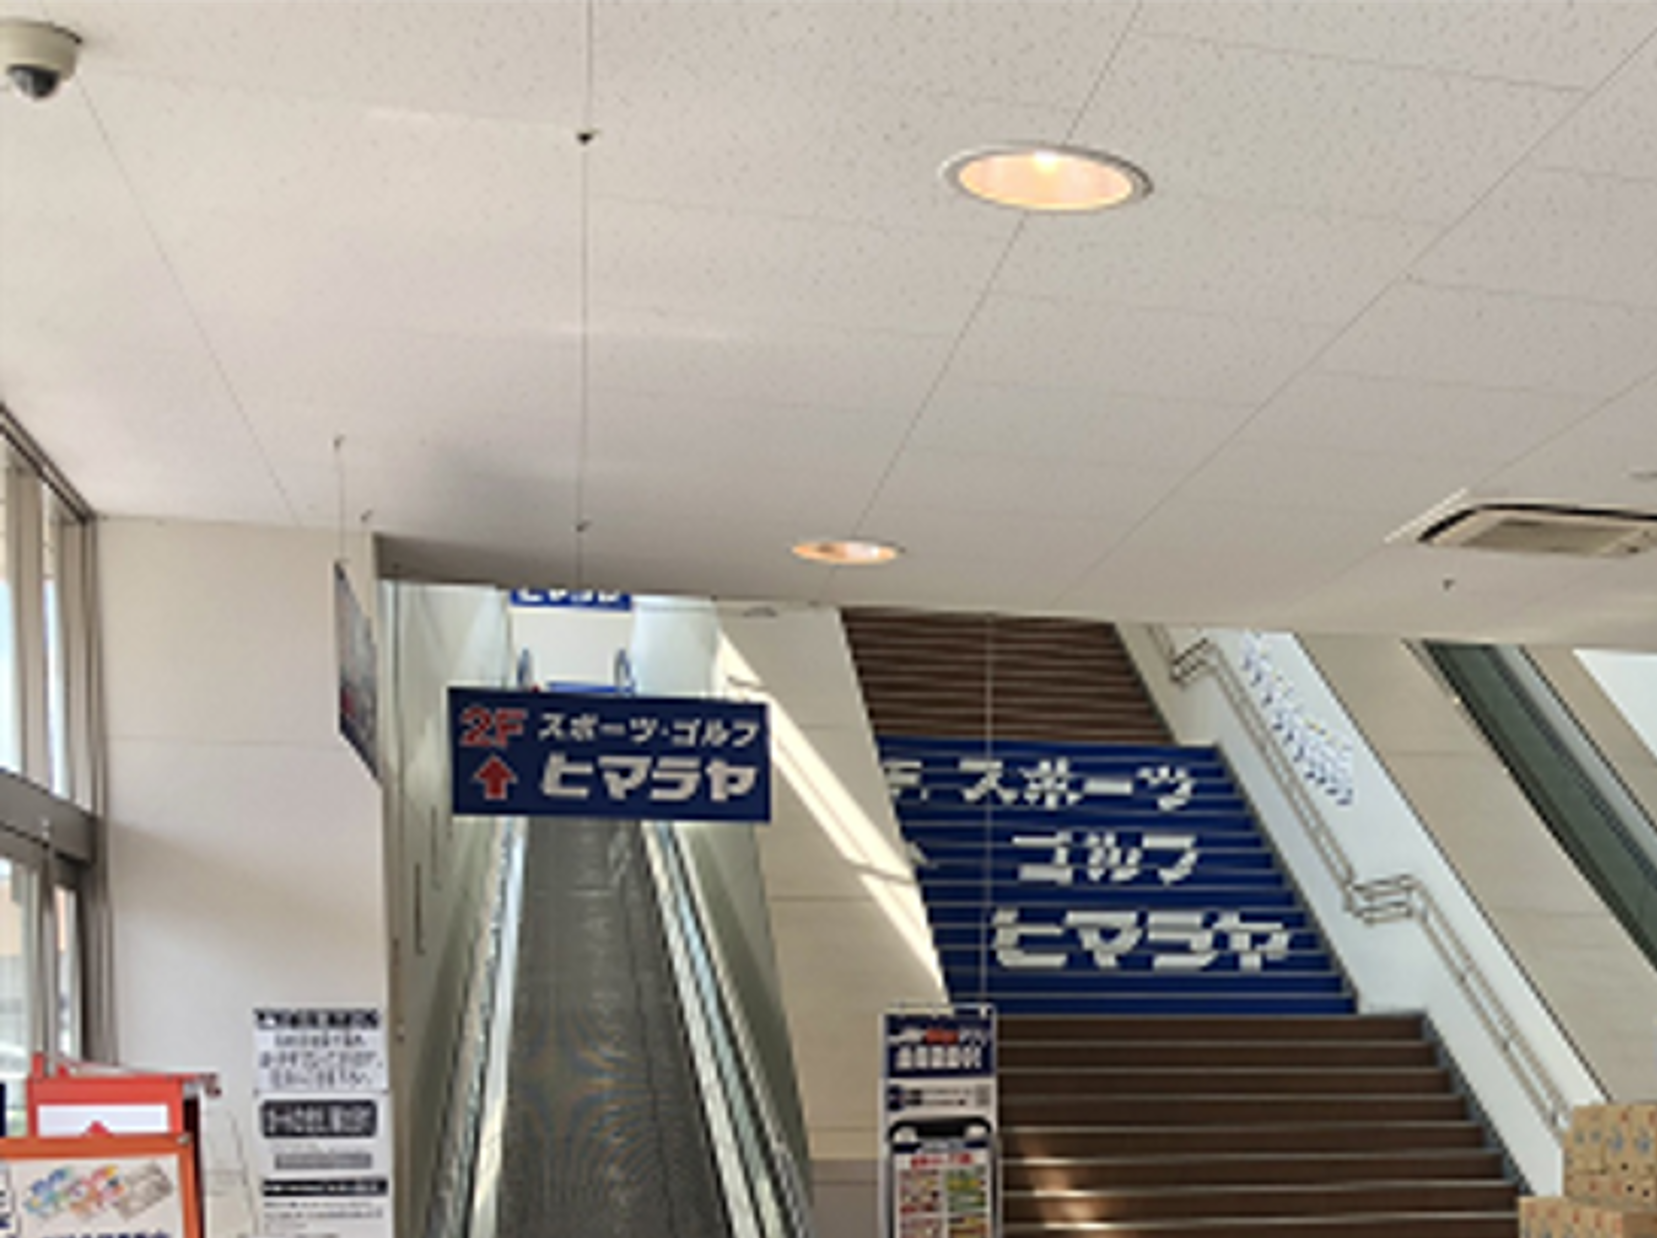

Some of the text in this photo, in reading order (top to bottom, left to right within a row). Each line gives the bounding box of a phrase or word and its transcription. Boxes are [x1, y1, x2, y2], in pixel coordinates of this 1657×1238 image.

[460, 708, 528, 747] 2F
[538, 711, 760, 748] スポーツ・ゴルフ
[540, 753, 760, 802] ヒマラヤ
[958, 757, 1199, 811] スポーツ
[1012, 831, 1199, 885] ゴルフ
[992, 909, 1291, 972] ヒマラヤ
